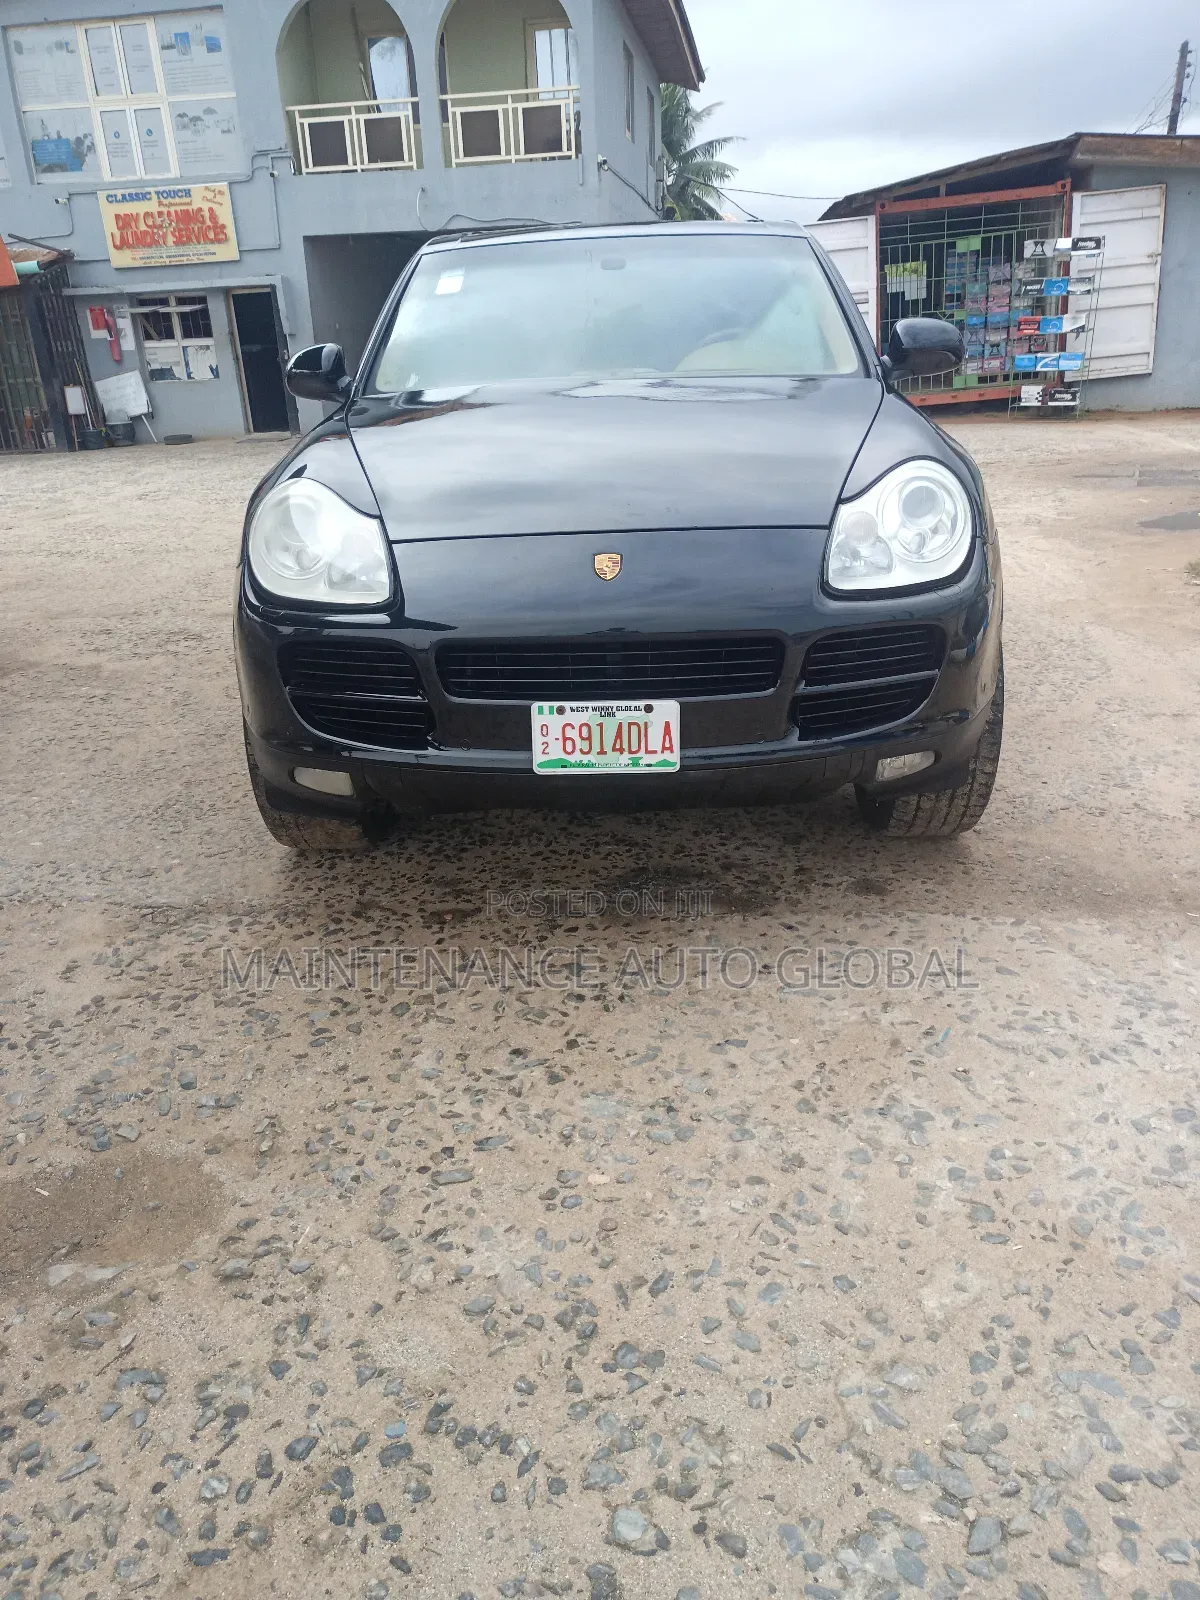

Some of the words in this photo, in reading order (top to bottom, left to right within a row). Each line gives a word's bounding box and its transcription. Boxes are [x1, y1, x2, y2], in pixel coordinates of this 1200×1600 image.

[106, 191, 152, 204] CLASSIC
[154, 188, 192, 201] TOUCH
[114, 212, 140, 231] DRY
[143, 207, 206, 230] CLEANING
[207, 206, 220, 225] &
[111, 228, 168, 250] LAUNDRY
[170, 223, 229, 246] SERVICES
